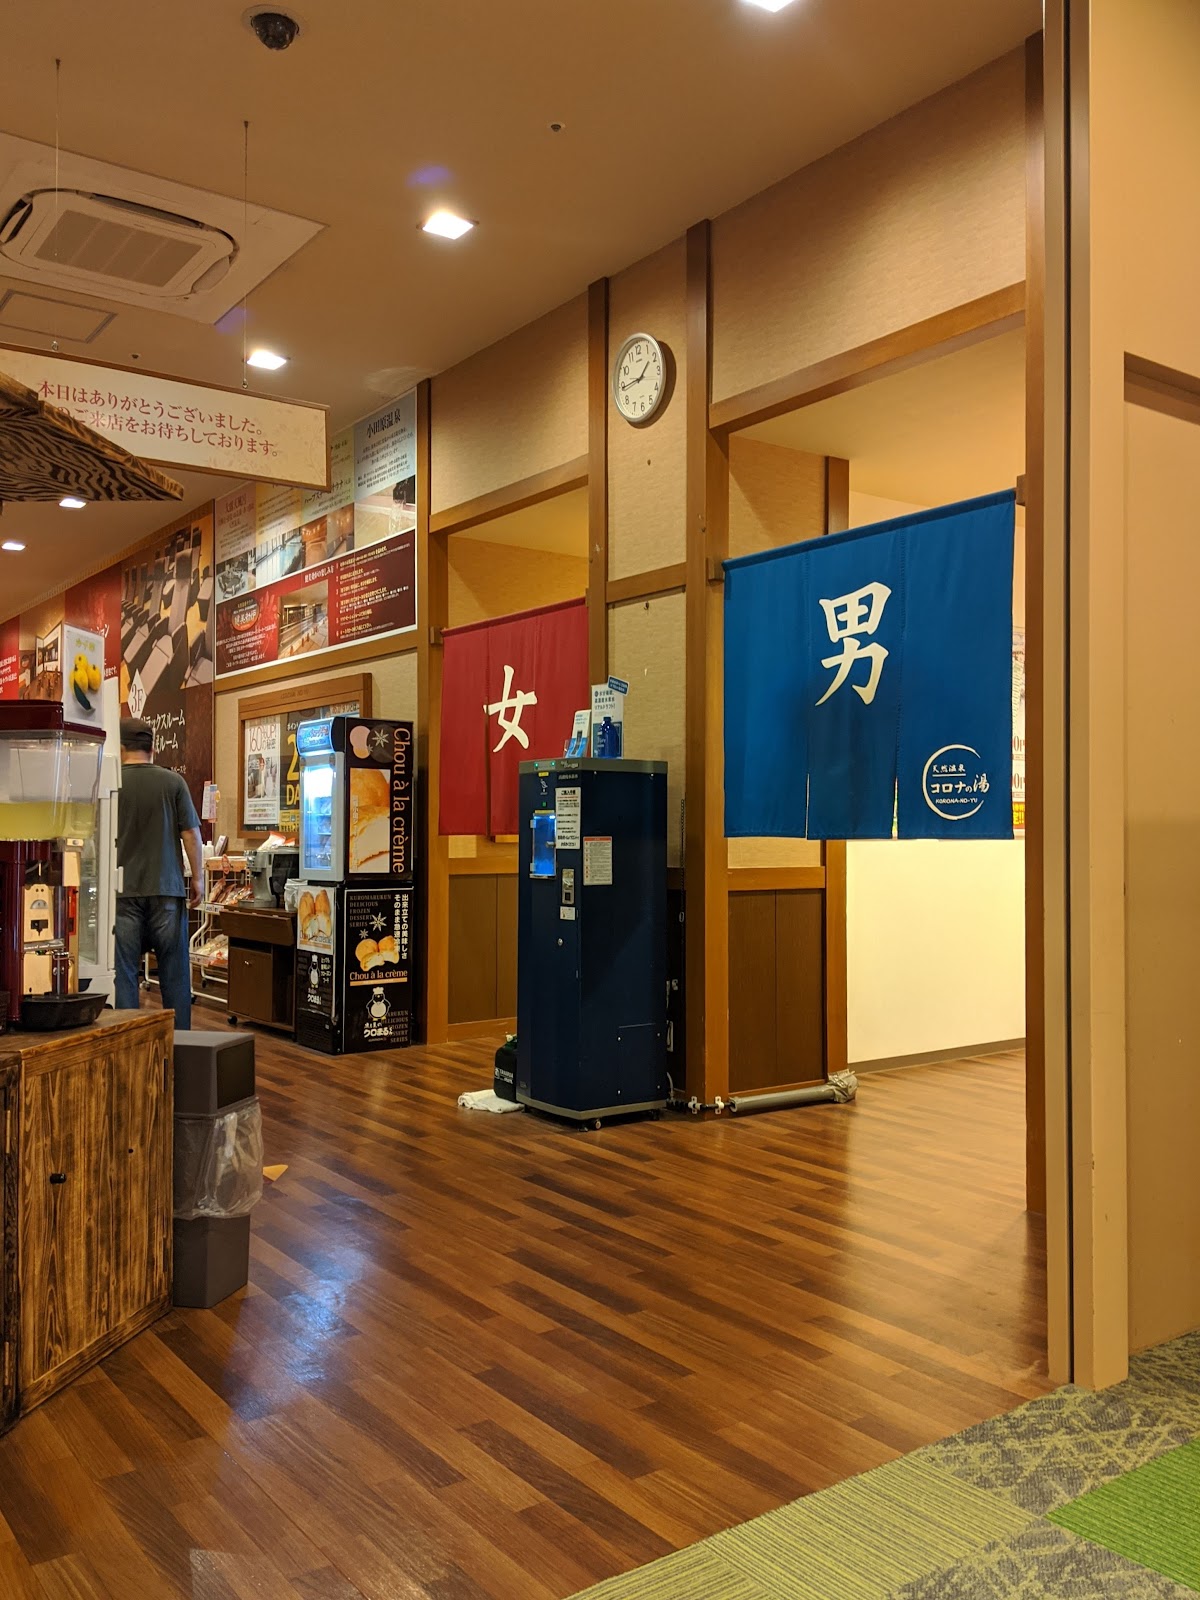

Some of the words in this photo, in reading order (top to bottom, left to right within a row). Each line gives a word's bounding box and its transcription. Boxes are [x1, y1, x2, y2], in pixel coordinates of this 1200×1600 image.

[634, 344, 642, 355] 12
[646, 344, 649, 354] 1
[628, 352, 634, 362] 11
[652, 352, 657, 362] 2
[622, 365, 630, 376] 10
[656, 366, 660, 376] 3
[654, 382, 658, 392] 4
[624, 394, 630, 405] 8
[648, 394, 653, 405] 5
[38, 379, 264, 436] 本日はありがとうございました。
[632, 402, 636, 412] 7
[640, 402, 646, 412] 6
[815, 581, 892, 706] 男
[131, 683, 144, 713] 3F
[483, 664, 538, 754] 女
[393, 727, 411, 775] Chou
[932, 763, 966, 773] 天然温泉
[930, 772, 990, 794] コロナの湯
[393, 796, 411, 812] la
[935, 797, 978, 805] KORONA-NO-YU
[392, 816, 410, 873] crème
[401, 893, 409, 960] 出来立ての美味しさ
[349, 970, 369, 982] Chou
[377, 969, 385, 979] la
[385, 969, 409, 979] crème
